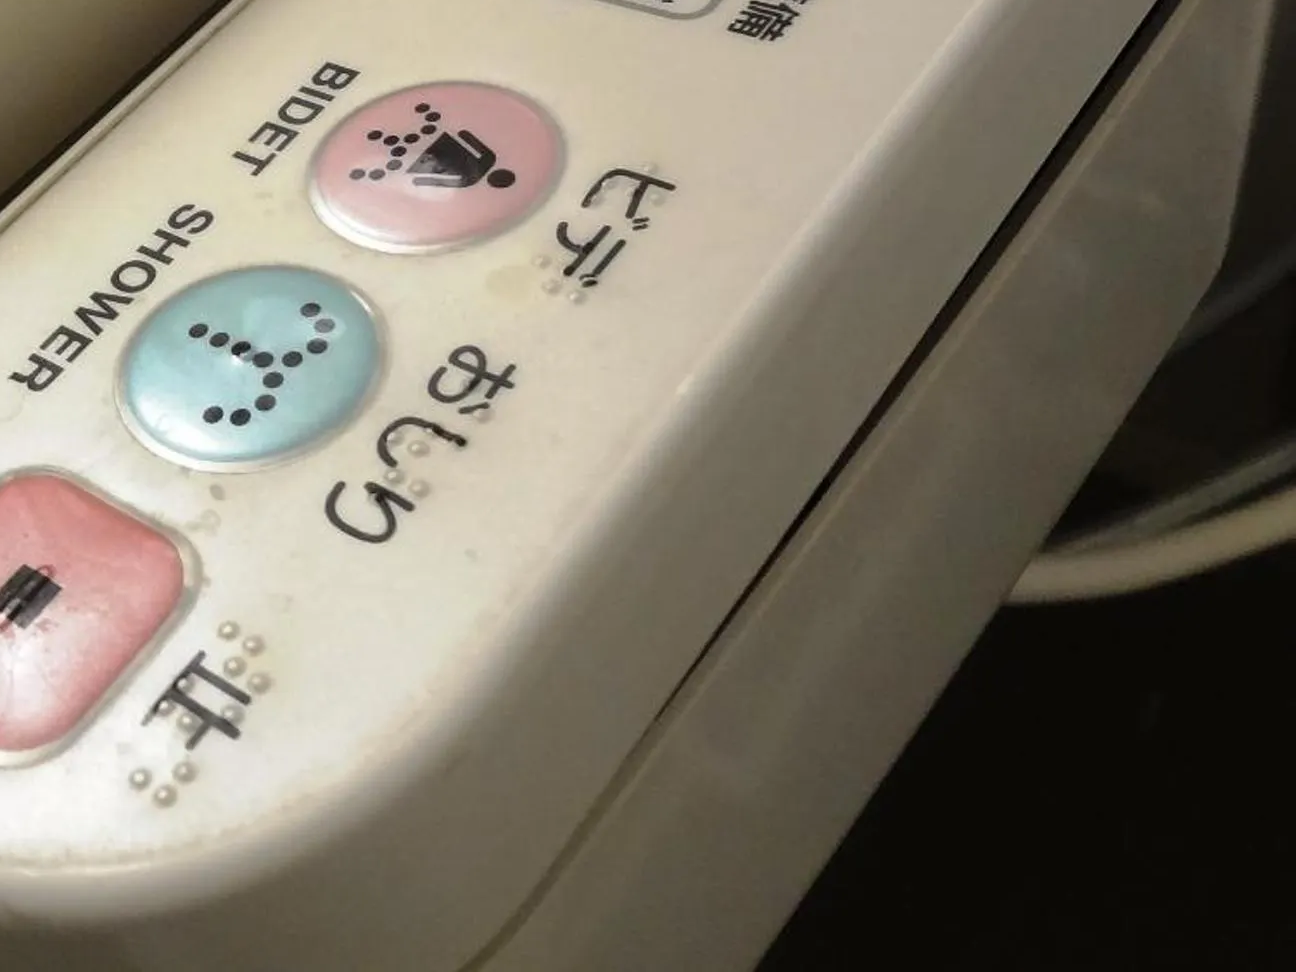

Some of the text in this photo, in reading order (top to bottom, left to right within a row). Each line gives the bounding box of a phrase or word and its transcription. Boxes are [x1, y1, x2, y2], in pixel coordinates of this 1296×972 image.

[232, 60, 361, 177] BIDET
[555, 167, 676, 288] ビデ
[7, 203, 215, 394] SHOWER
[324, 344, 517, 544] おしり
[141, 650, 253, 750] 止
